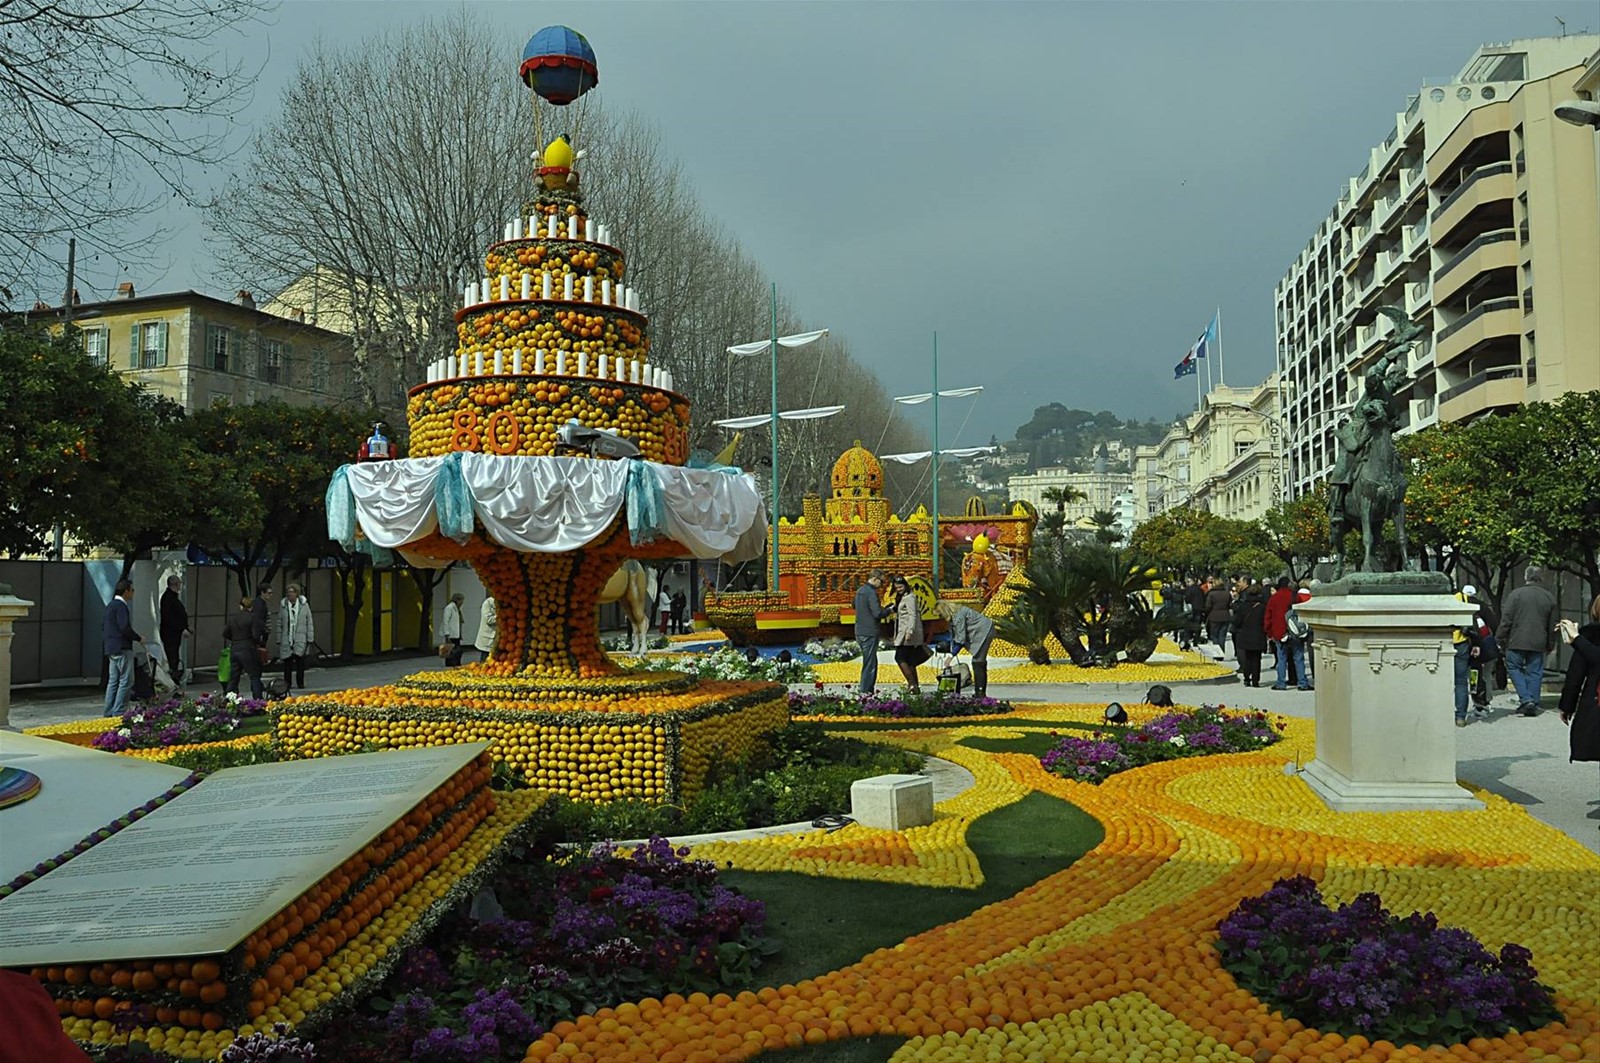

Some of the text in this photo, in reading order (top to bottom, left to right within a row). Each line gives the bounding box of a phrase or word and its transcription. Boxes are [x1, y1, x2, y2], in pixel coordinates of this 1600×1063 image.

[452, 411, 519, 454] 80
[663, 422, 689, 462] 80
[1270, 420, 1280, 459] HOTEL
